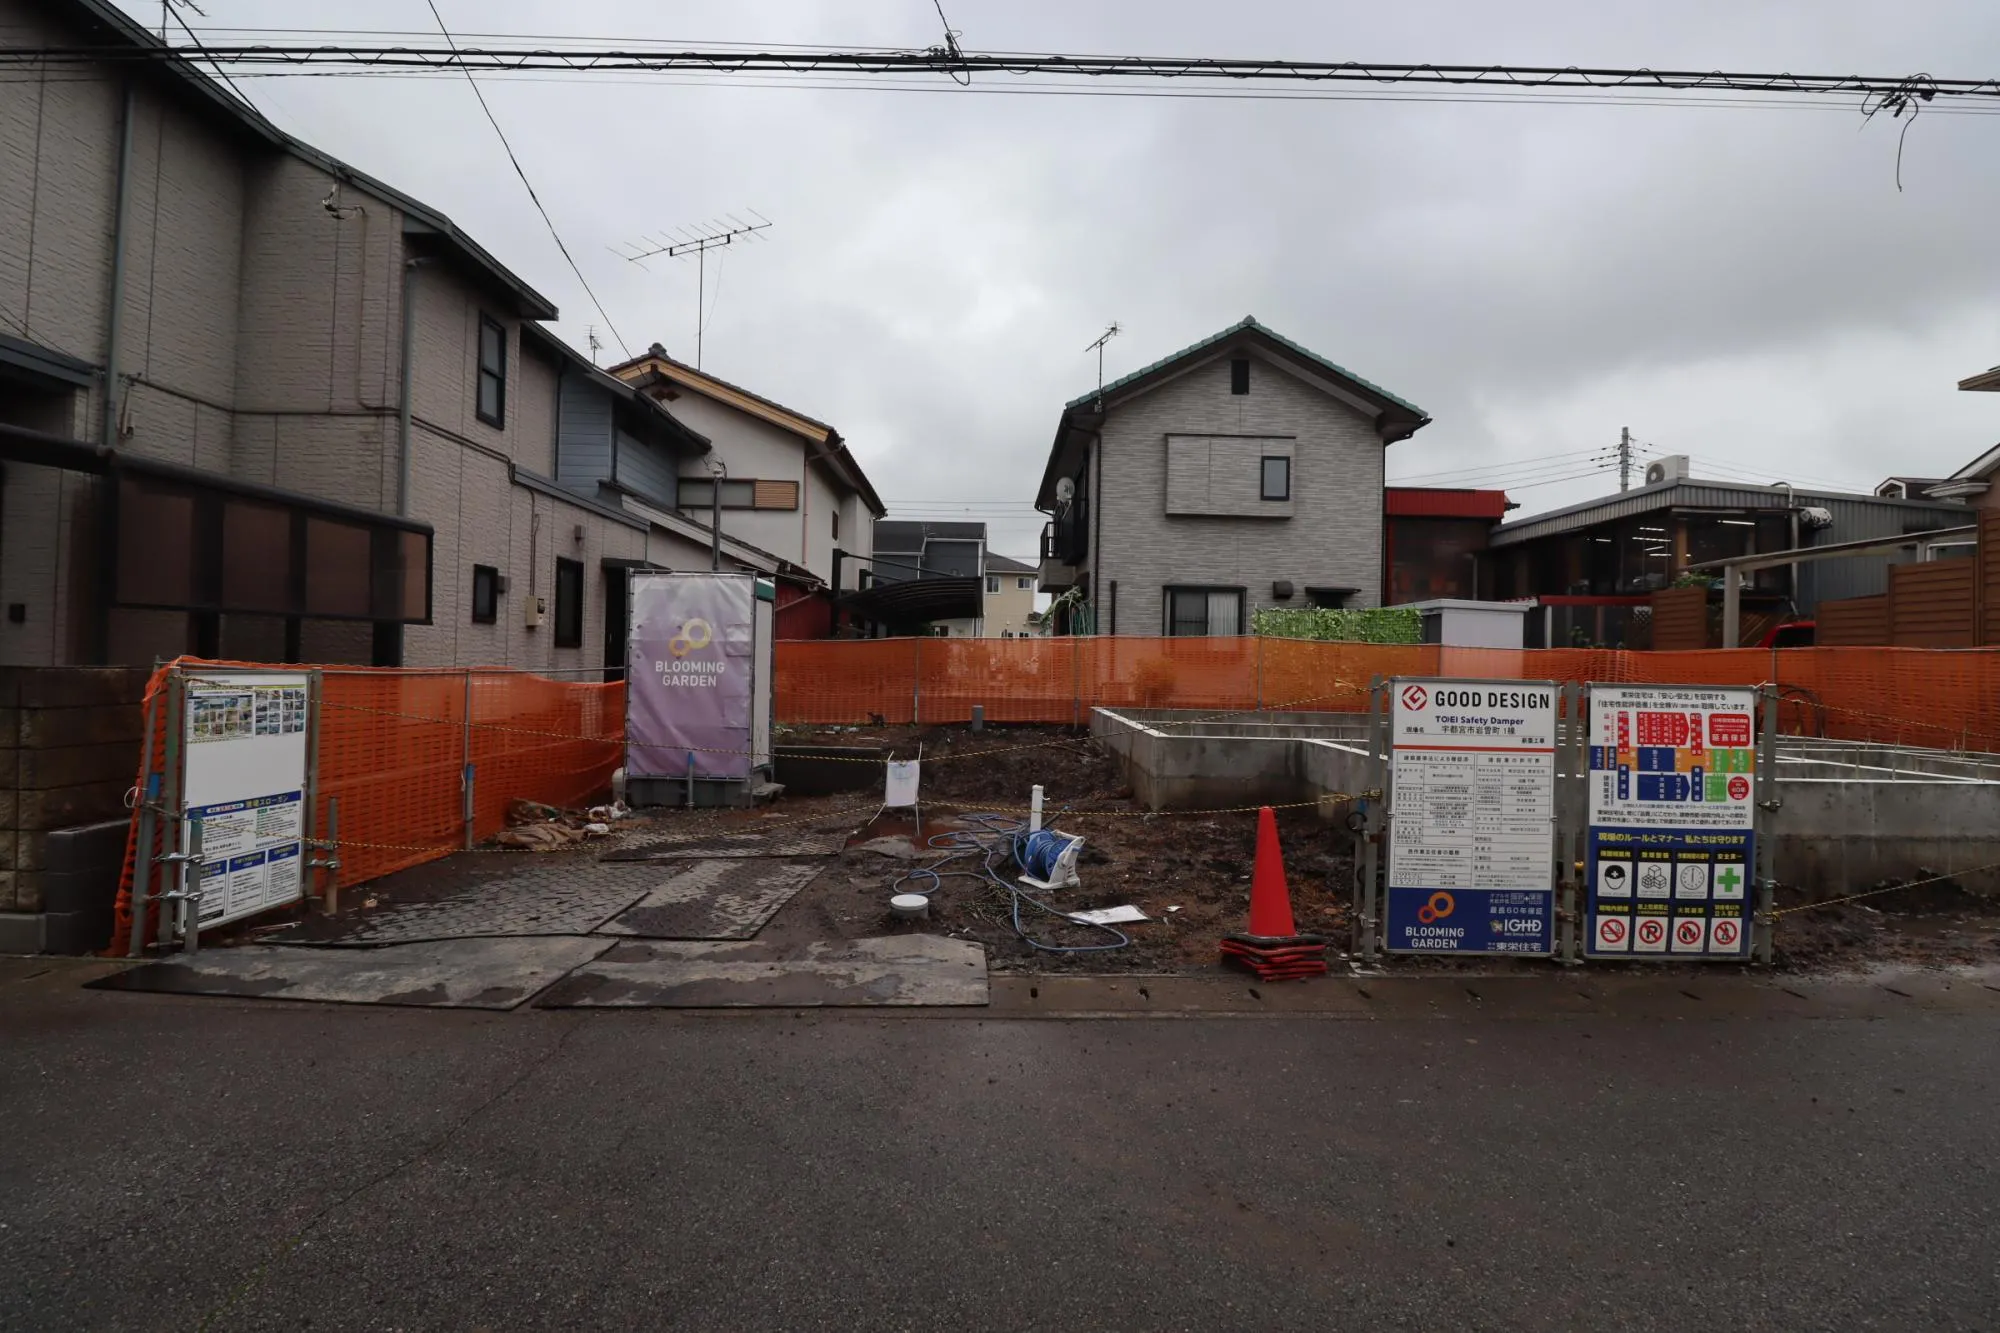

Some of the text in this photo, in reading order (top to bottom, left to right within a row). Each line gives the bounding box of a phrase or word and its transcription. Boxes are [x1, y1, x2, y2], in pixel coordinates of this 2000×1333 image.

[655, 660, 725, 674] BLOOMING
[662, 674, 717, 687] GARDEN
[1435, 690, 1550, 709] GOOD DESIGN
[1460, 715, 1488, 726] Safety
[1490, 716, 1525, 726] Damper
[1684, 834, 1747, 845] 私たちは守ります
[1504, 918, 1542, 932] IGHD
[1405, 926, 1465, 938] BLOOMING
[1411, 938, 1458, 948] GARDEN
